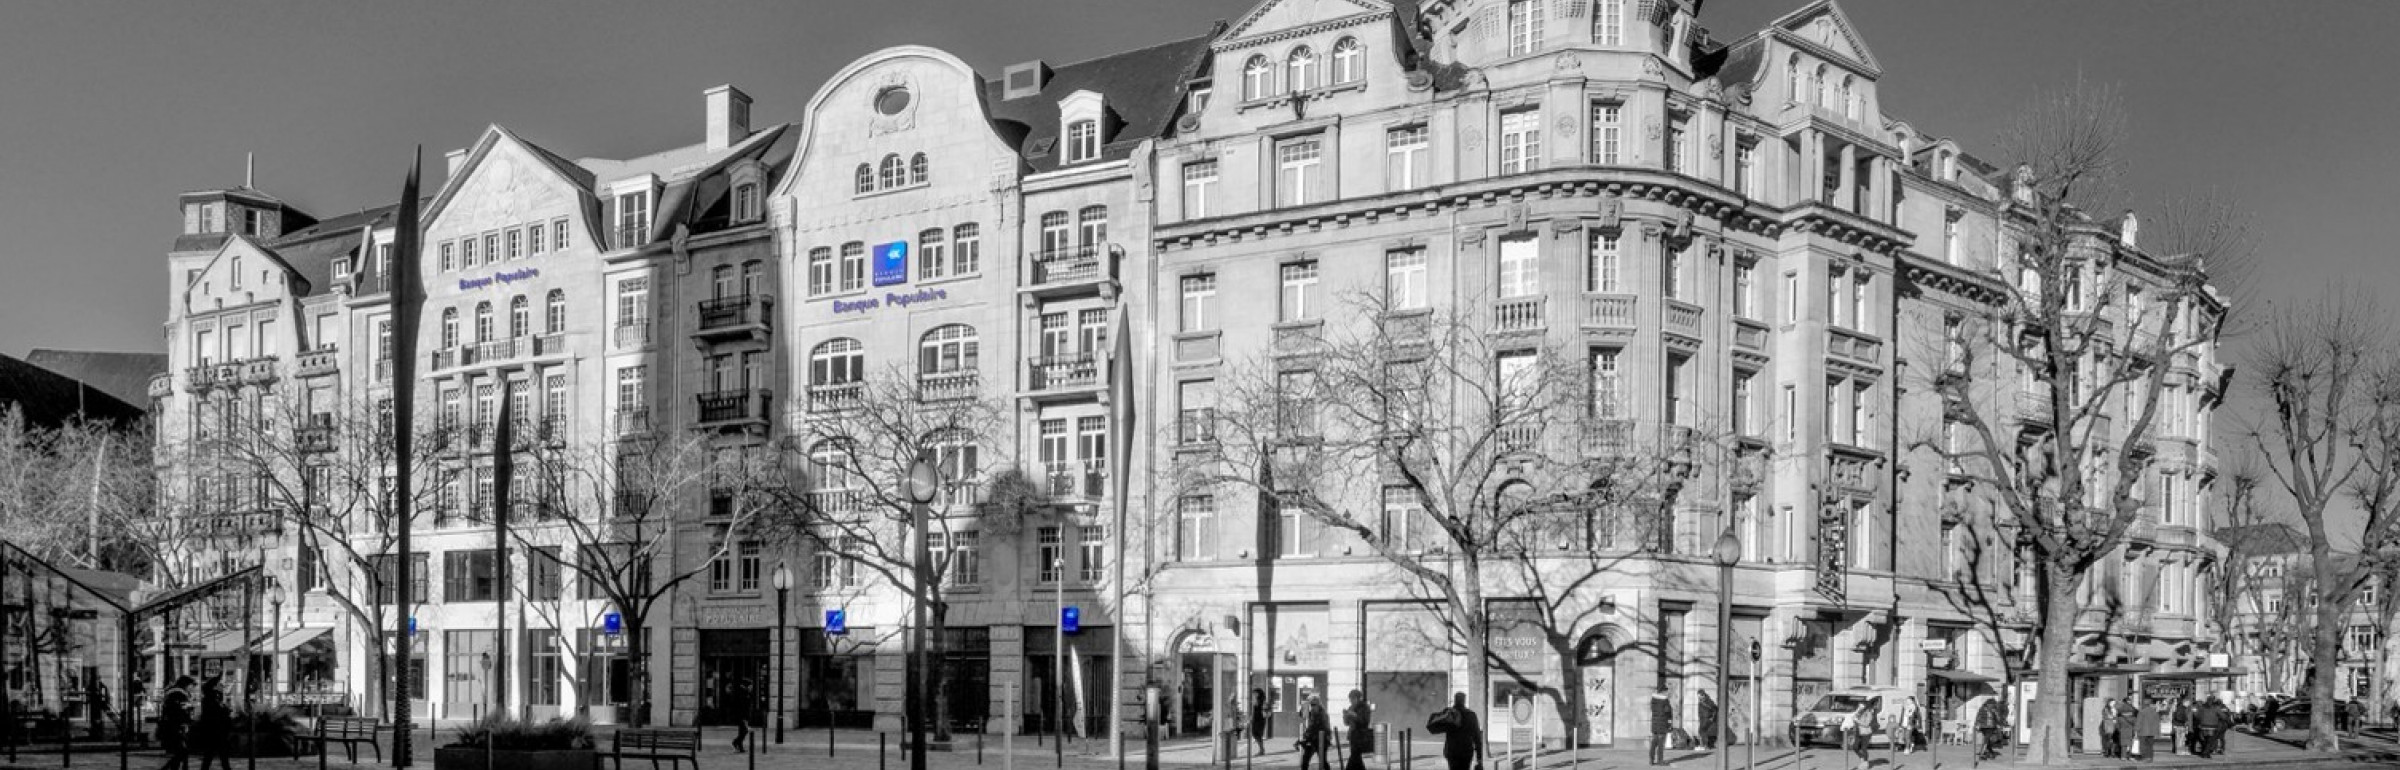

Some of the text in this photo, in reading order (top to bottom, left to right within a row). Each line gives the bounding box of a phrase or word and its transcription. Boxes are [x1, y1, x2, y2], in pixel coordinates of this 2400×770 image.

[459, 267, 539, 290] Banque Populaire
[834, 288, 947, 314] Banque Populaire
